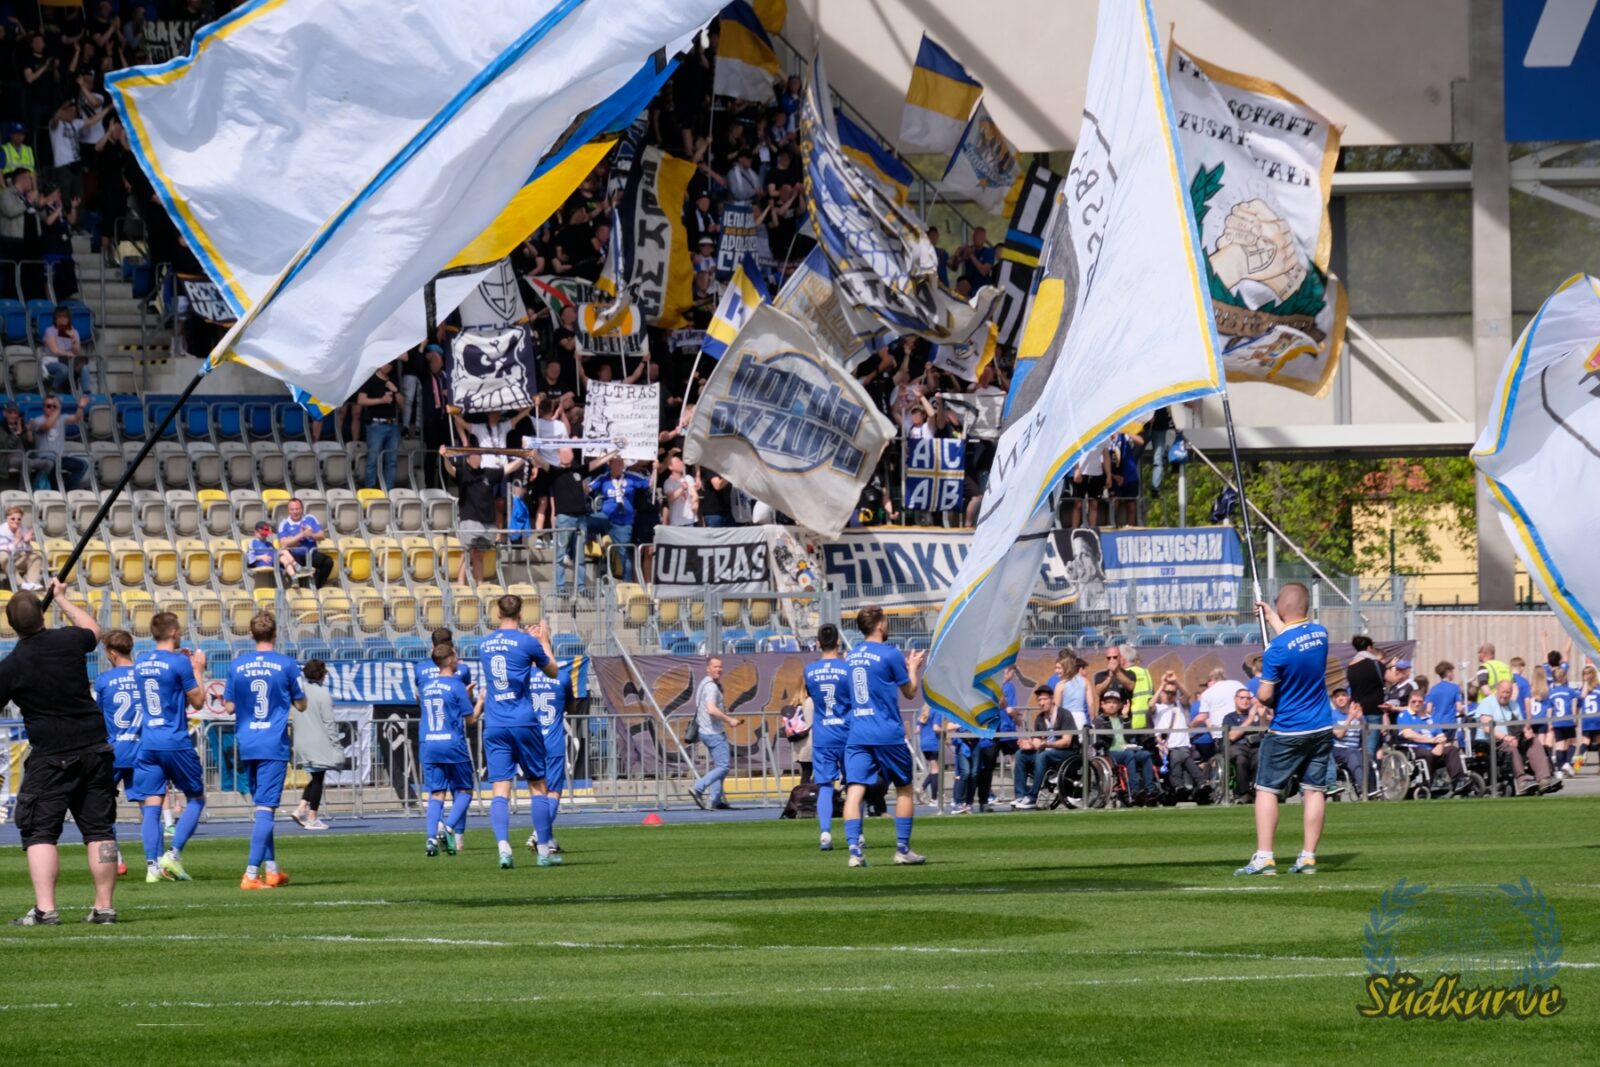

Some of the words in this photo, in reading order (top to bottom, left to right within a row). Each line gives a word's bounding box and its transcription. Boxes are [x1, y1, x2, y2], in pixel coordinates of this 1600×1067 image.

[591, 382, 657, 399] ULTRAS
[1116, 534, 1223, 564] UNBEUGSAM
[655, 543, 768, 583] ULTRAS
[484, 645, 509, 653] JENA
[1287, 639, 1297, 650] FC
[1299, 639, 1324, 652] JENA
[490, 655, 510, 690] 9
[849, 659, 871, 667] JENA
[244, 669, 272, 678] JENA
[814, 673, 839, 681] JENA
[852, 667, 869, 704] 8
[144, 678, 162, 716] 6
[250, 679, 269, 719] 3
[820, 683, 837, 716] 7
[1554, 697, 1566, 717] 9
[1584, 694, 1599, 714] 5
